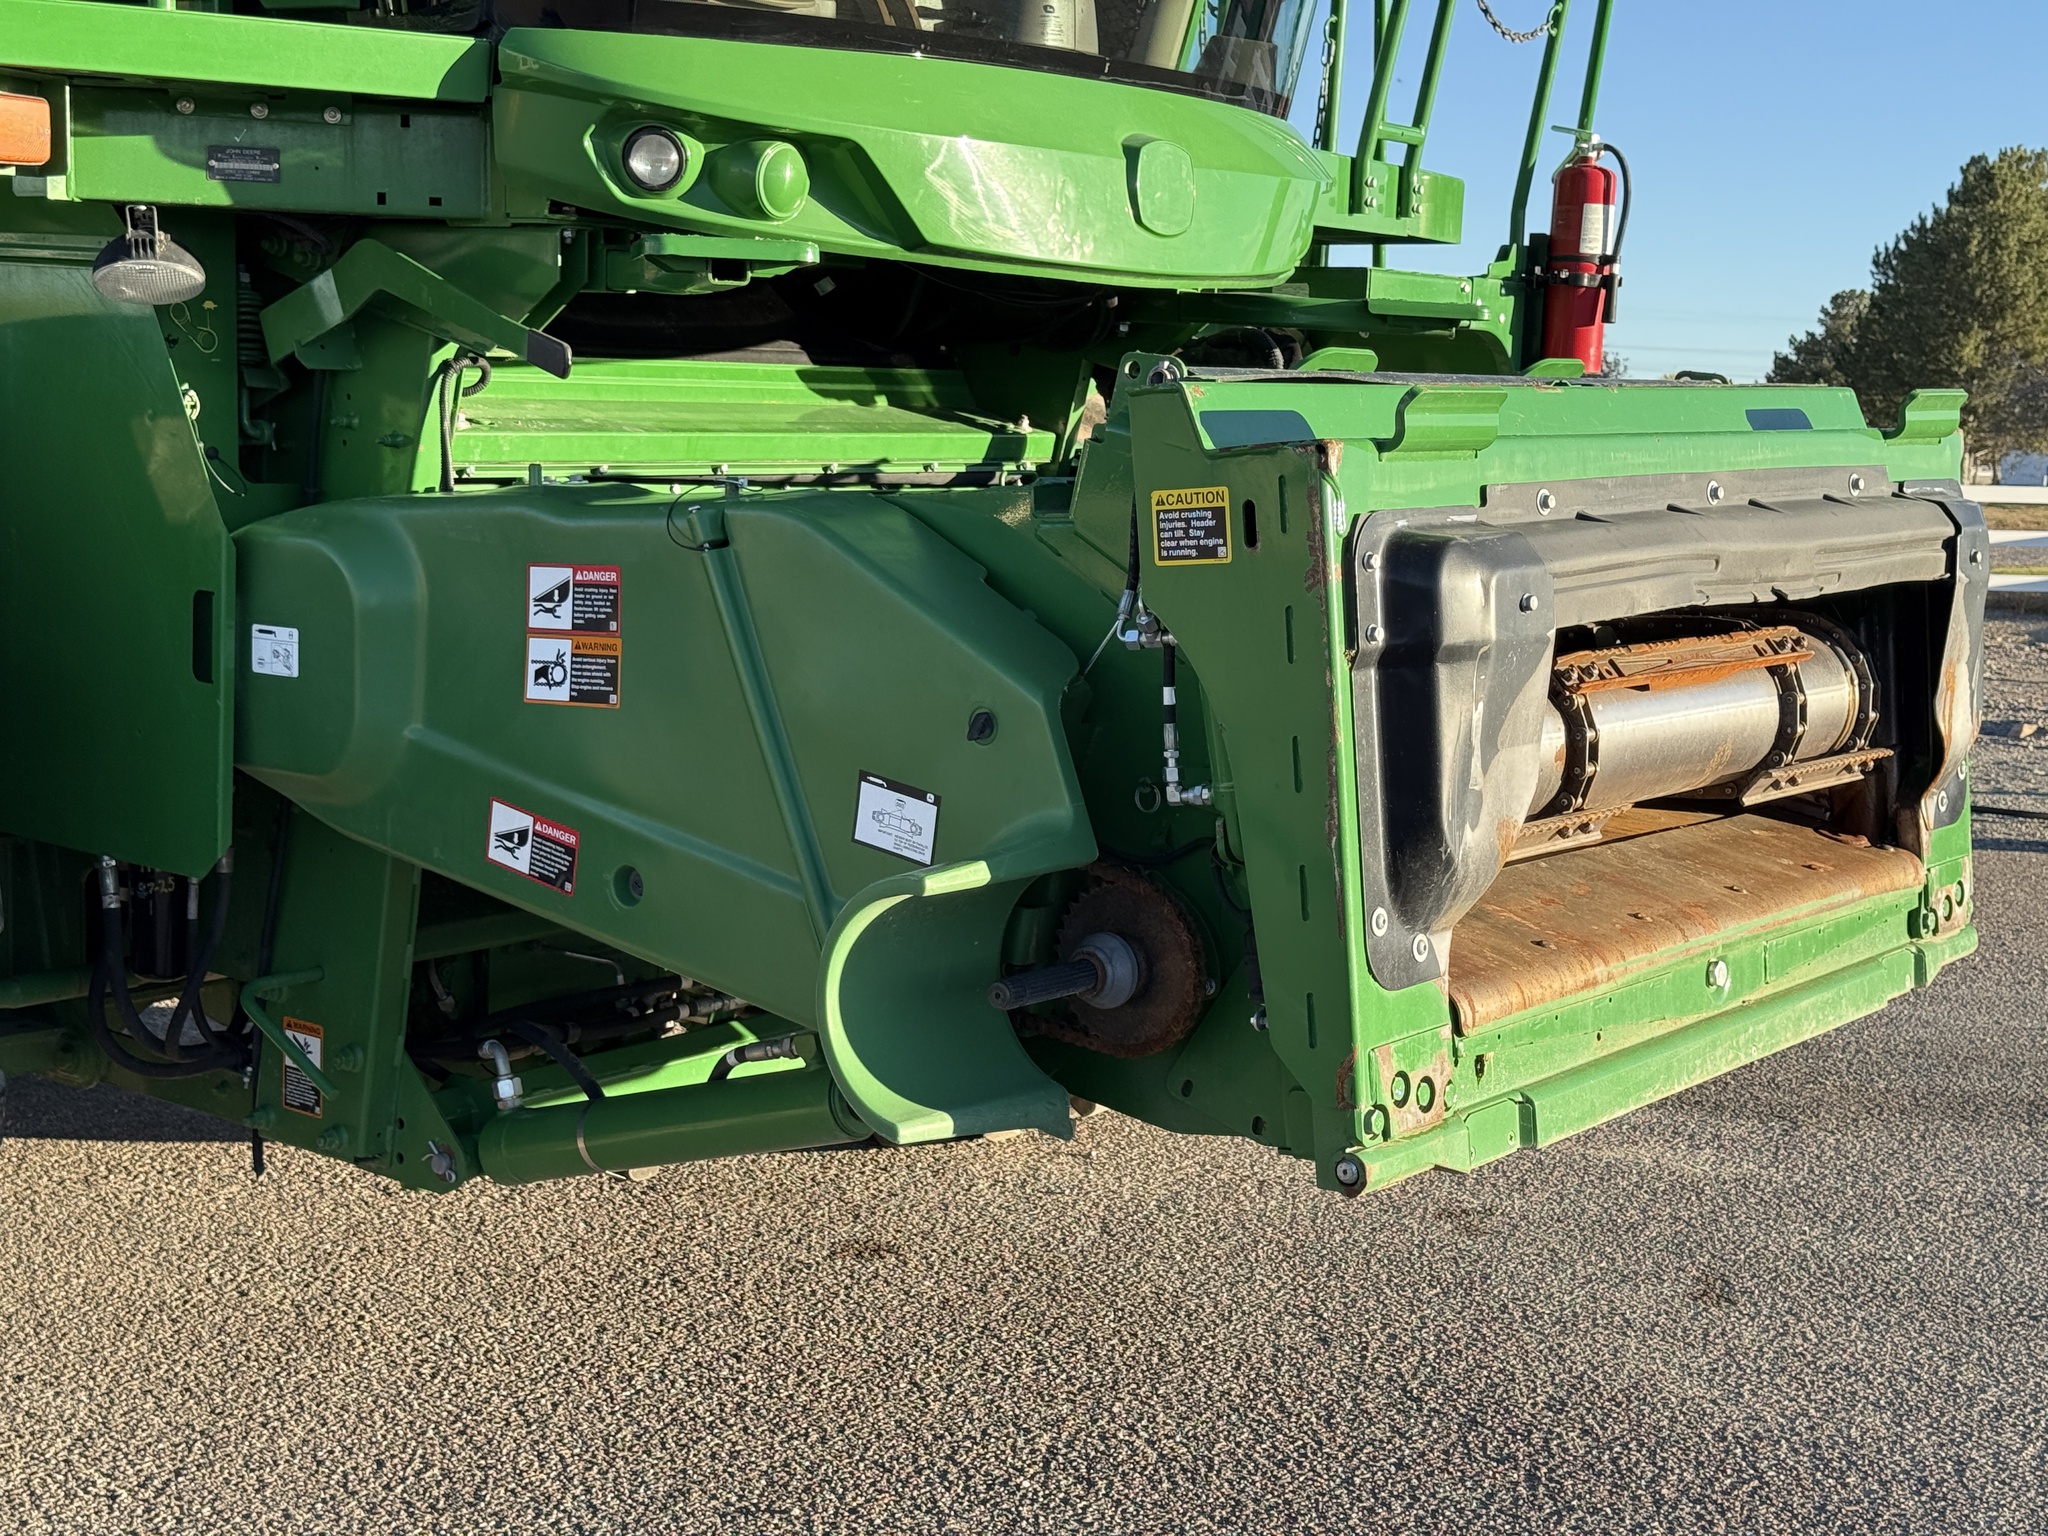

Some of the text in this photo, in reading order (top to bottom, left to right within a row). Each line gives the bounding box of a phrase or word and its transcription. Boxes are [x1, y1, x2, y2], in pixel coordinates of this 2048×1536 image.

[1166, 490, 1225, 506] CAUTION
[1159, 509, 1212, 520] Avoid crushing
[1160, 519, 1216, 530] injuries. Header
[1174, 529, 1186, 538] tilt.
[1189, 528, 1205, 538] Stay
[1160, 537, 1224, 547] clear when engine
[1161, 548, 1199, 558] is running.
[583, 571, 617, 582] DANGER
[581, 642, 618, 652] WARNING
[542, 824, 577, 846] DANGER
[293, 1021, 321, 1035] WARNING
